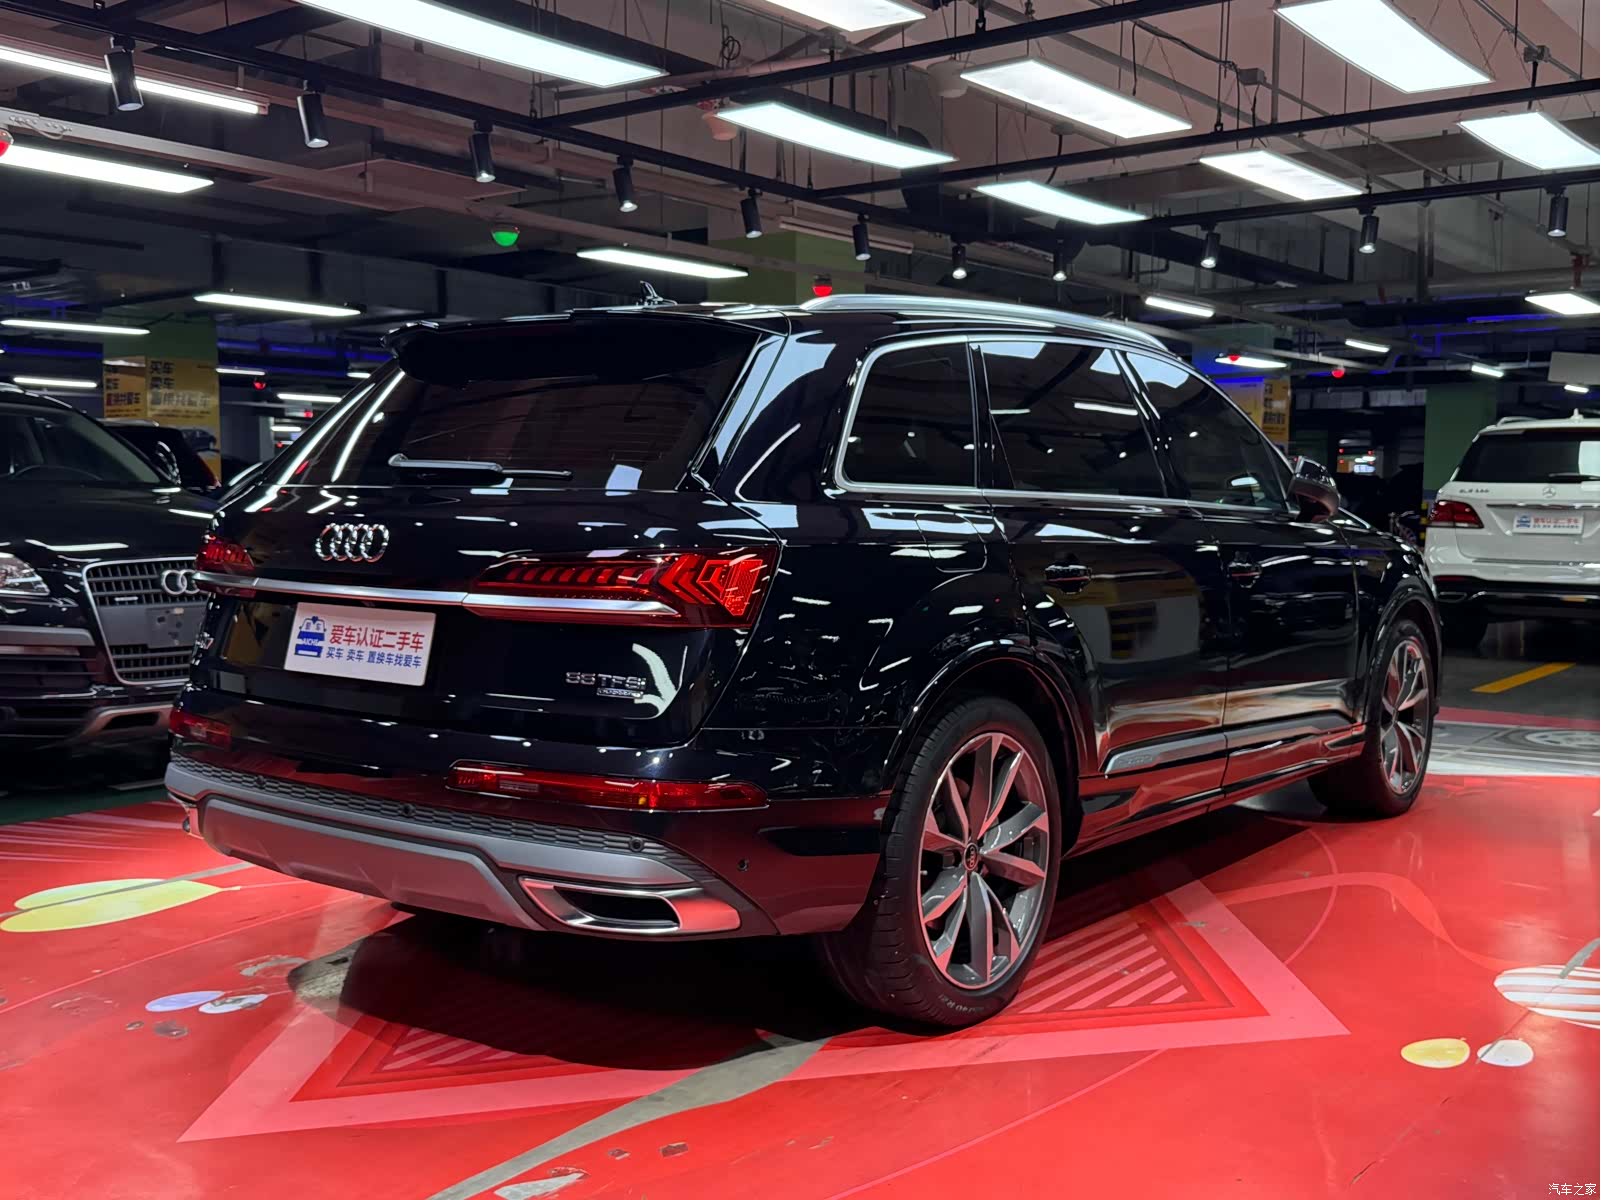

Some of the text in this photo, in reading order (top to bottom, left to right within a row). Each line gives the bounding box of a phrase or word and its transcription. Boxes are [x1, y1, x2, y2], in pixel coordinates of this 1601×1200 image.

[329, 624, 425, 653] 爱车认证二手车
[326, 646, 422, 669] 买车 卖车 置换车找爱车
